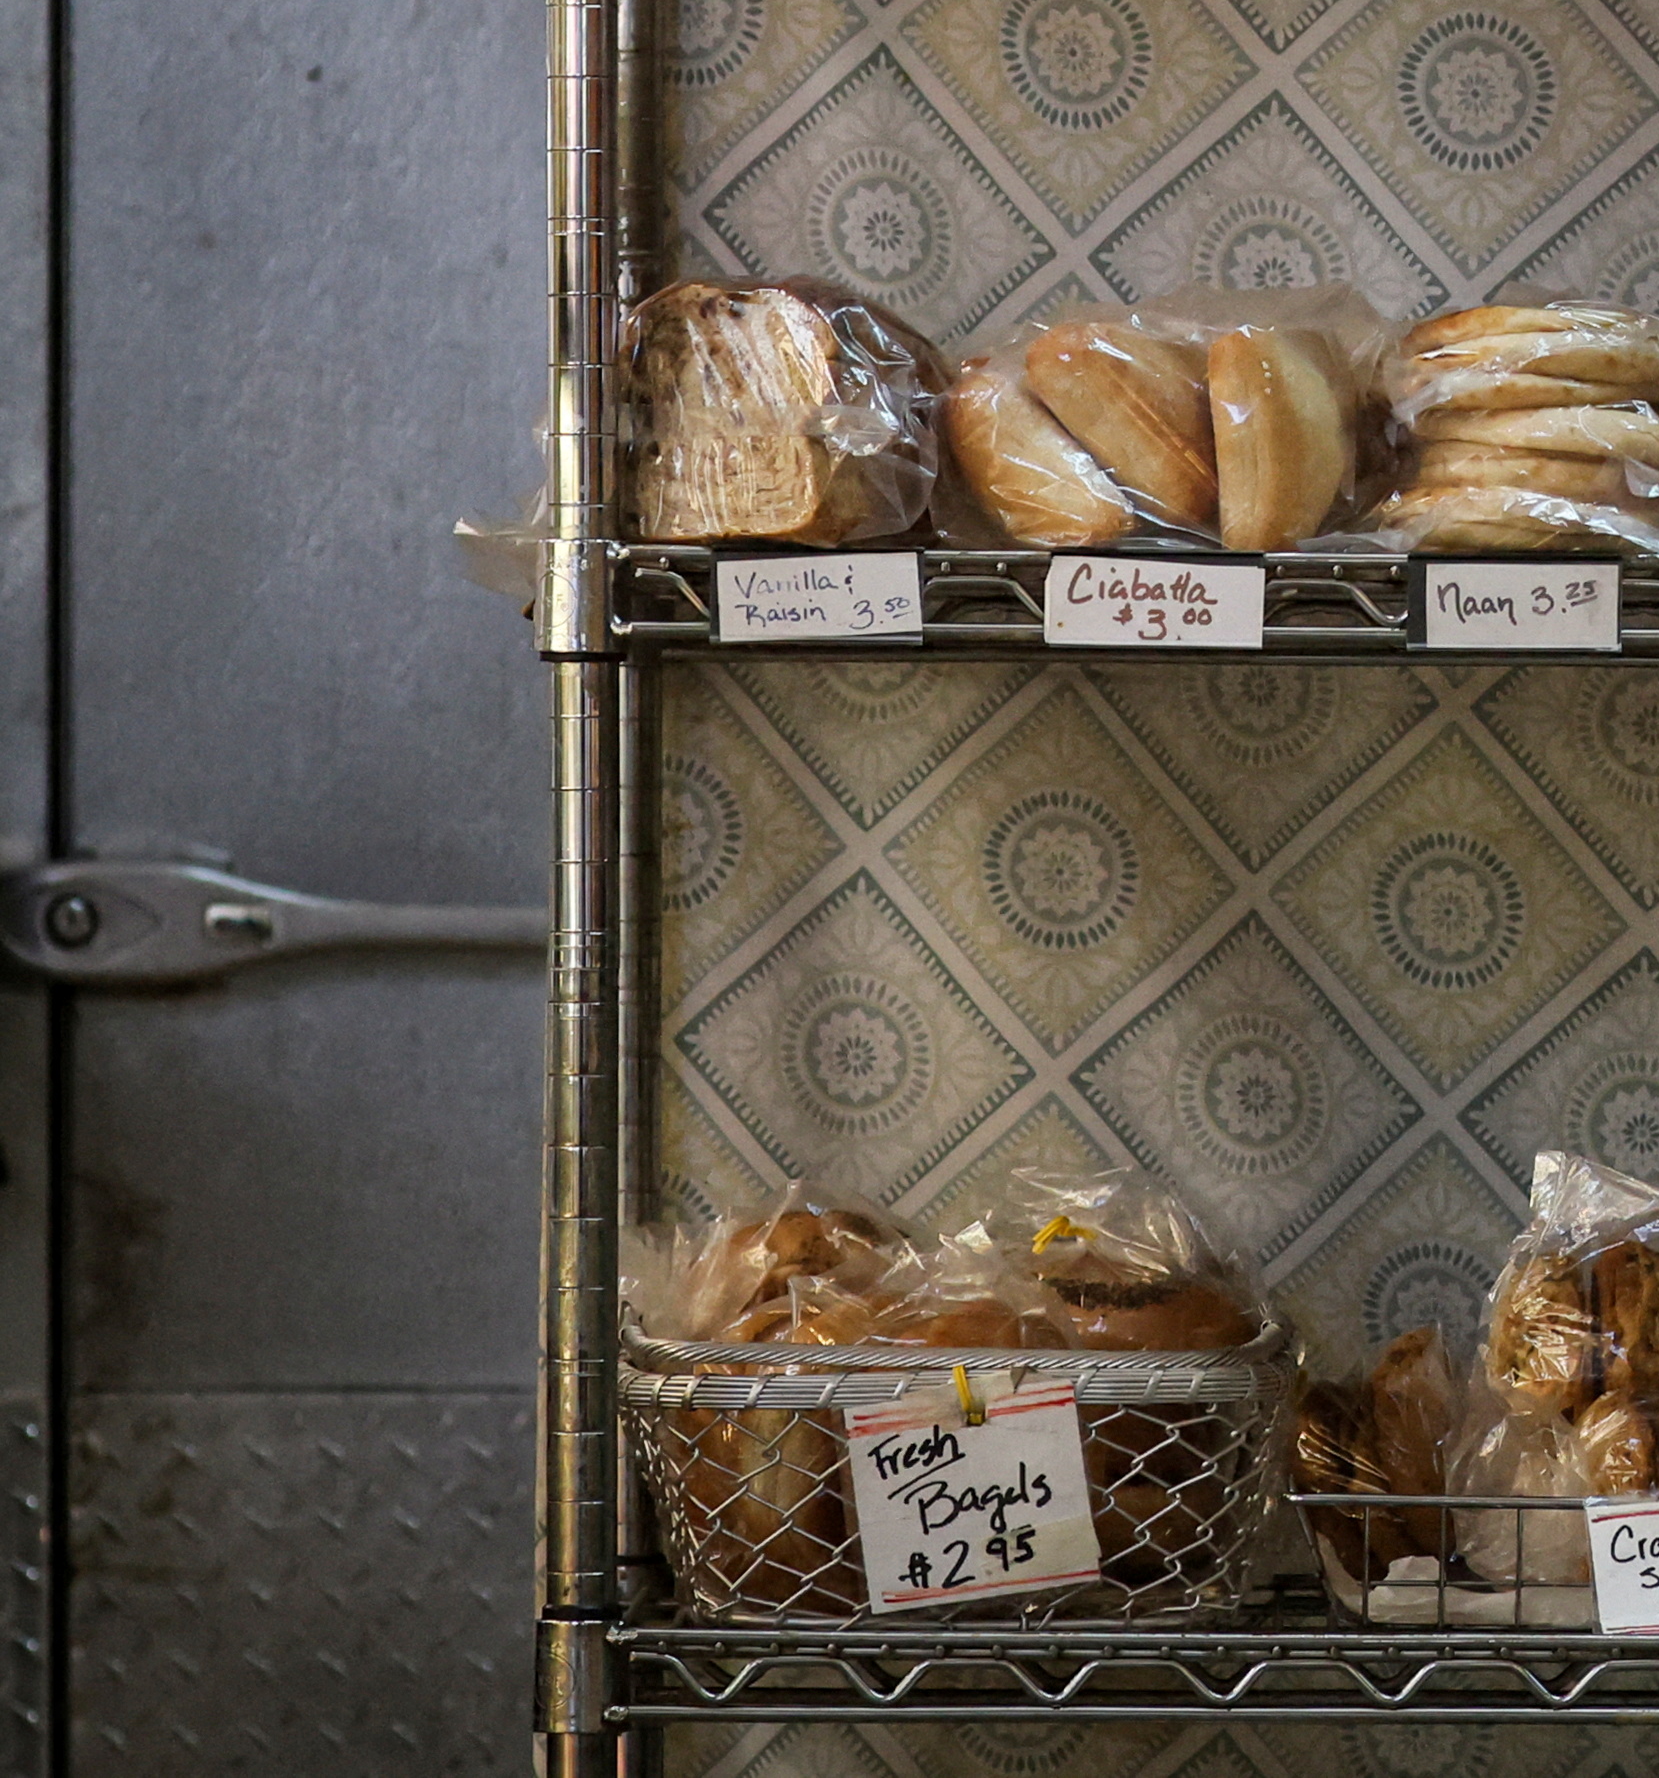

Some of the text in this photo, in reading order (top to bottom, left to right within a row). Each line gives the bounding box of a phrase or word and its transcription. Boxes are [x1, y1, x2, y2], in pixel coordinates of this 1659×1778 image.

[734, 569, 840, 599] Vanilla
[1067, 562, 1219, 604] Ciabatta
[734, 598, 827, 628] Raisin
[867, 1424, 967, 1480] Fresh
[903, 1461, 1053, 1536] Bagels
